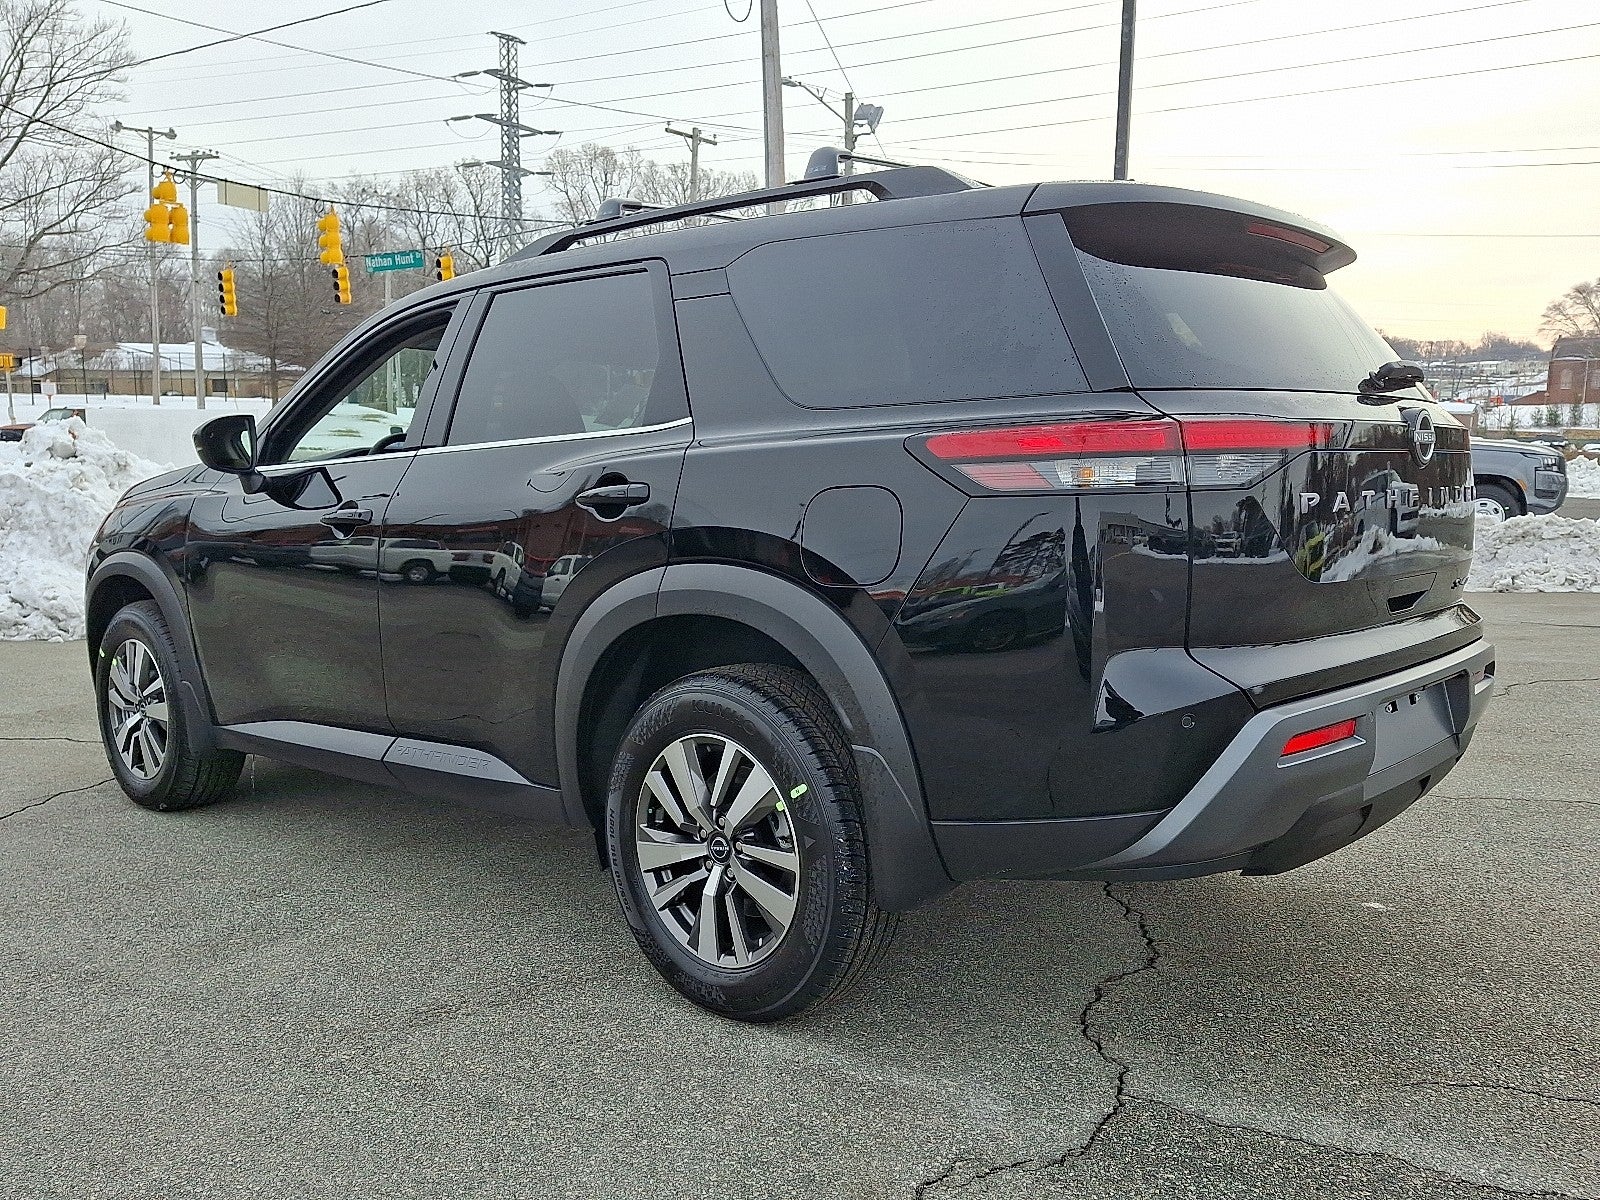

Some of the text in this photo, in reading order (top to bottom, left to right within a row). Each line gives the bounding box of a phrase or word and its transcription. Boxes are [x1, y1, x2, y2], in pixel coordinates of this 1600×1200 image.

[366, 256, 392, 267] Nathan
[394, 253, 414, 265] Hunt
[394, 745, 491, 771] PATHFINDER
